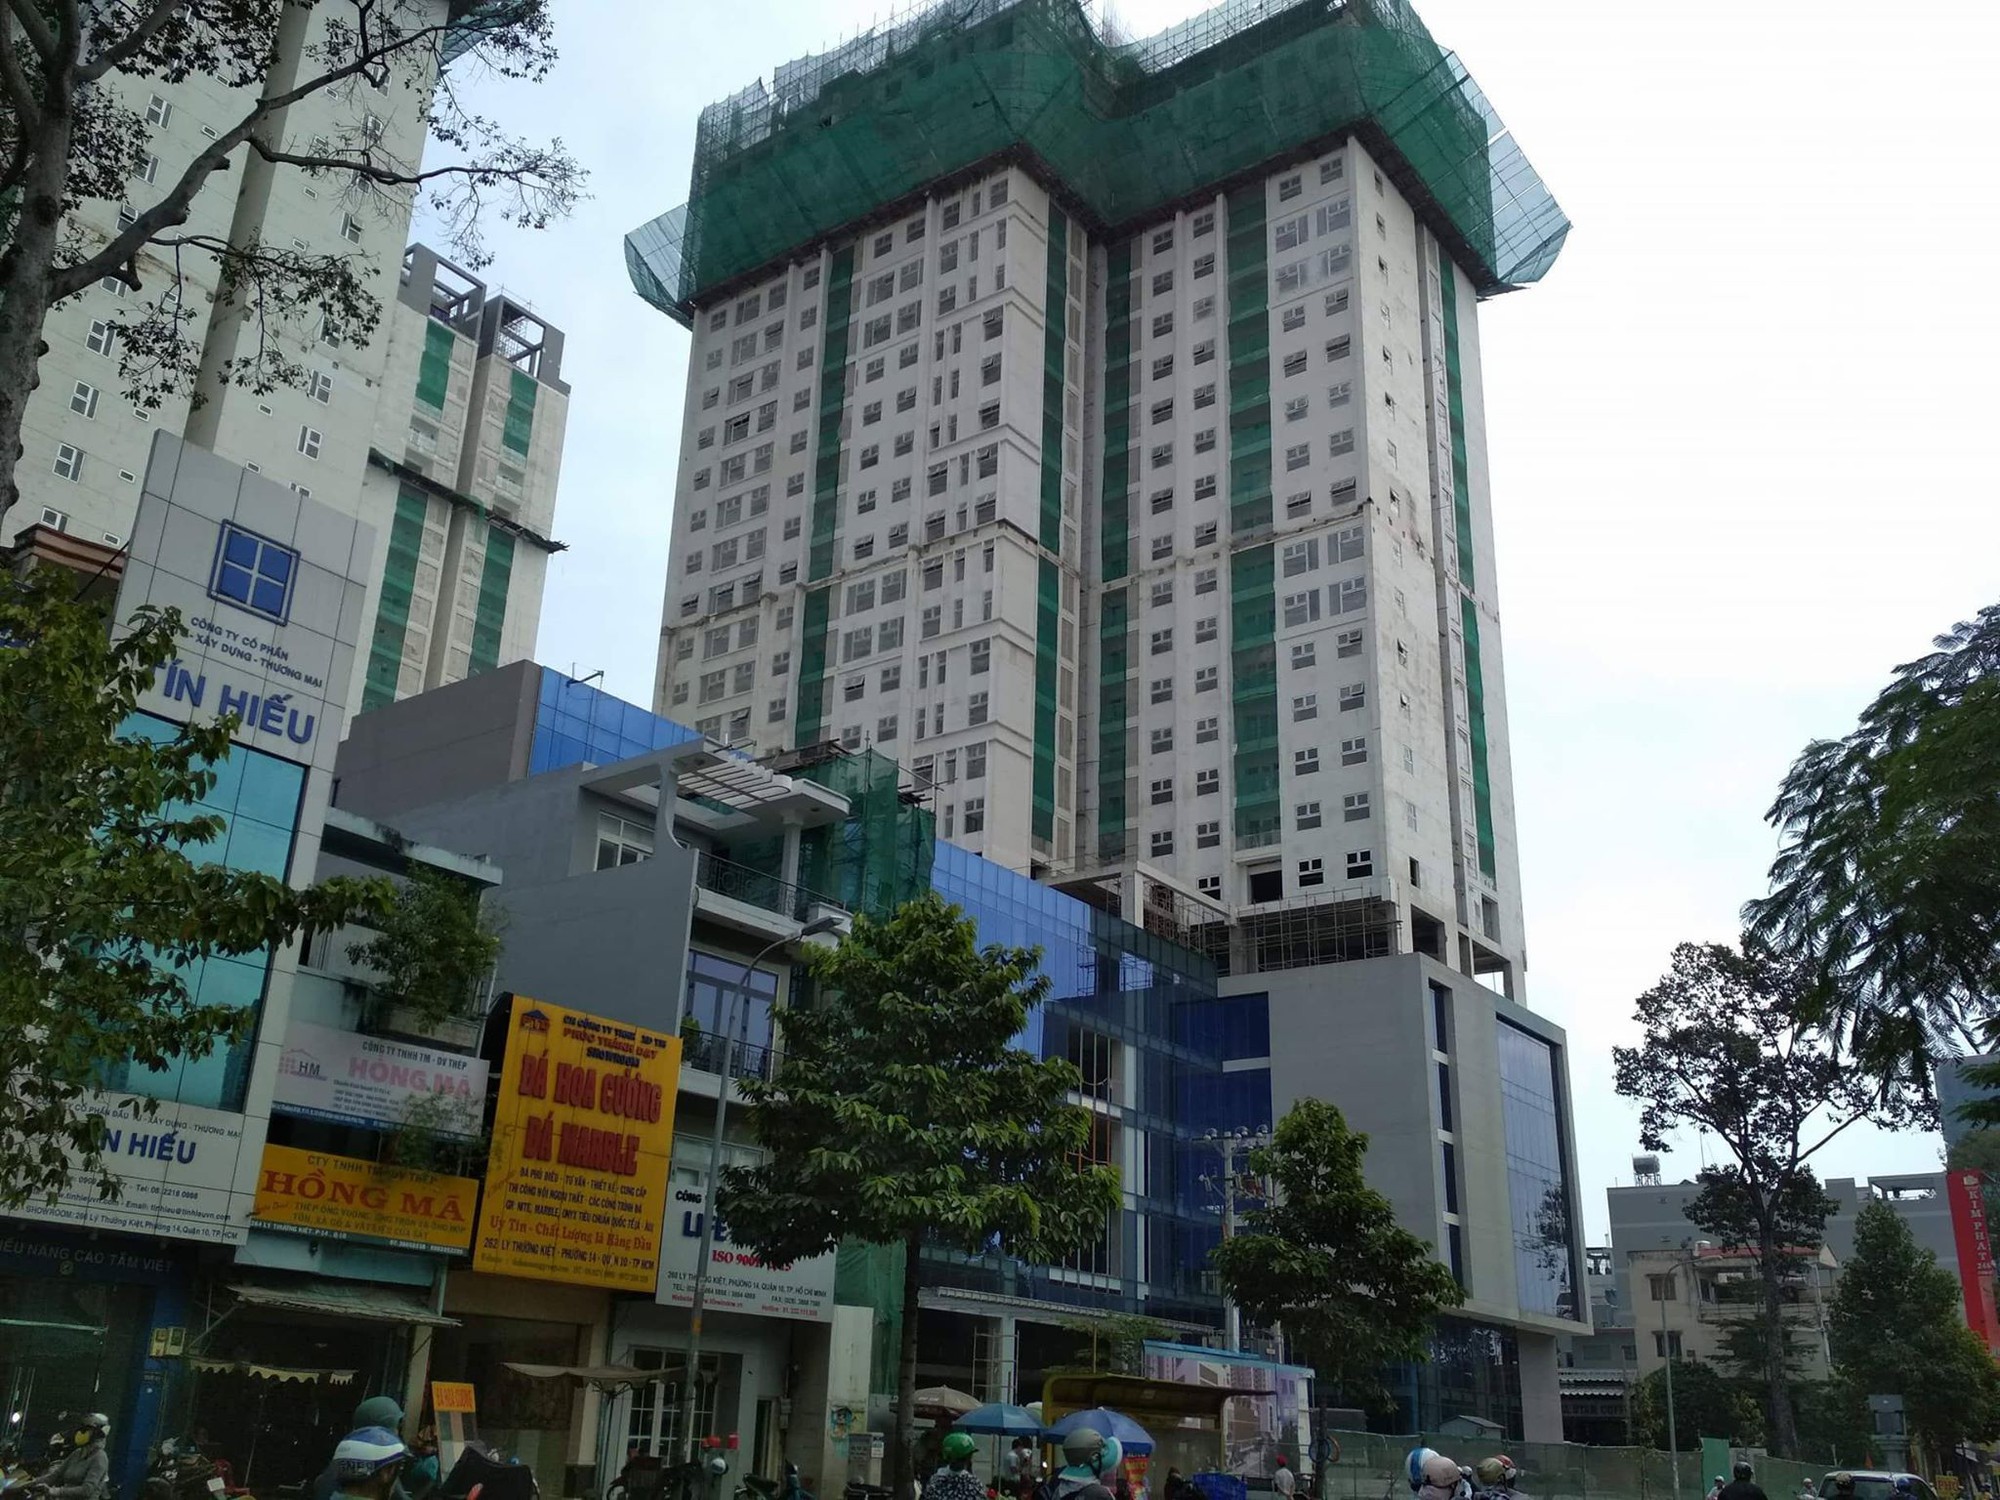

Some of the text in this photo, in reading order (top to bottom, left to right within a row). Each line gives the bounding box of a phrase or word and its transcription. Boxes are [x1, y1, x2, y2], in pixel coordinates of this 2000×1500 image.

[190, 616, 222, 636] CÔNG
[225, 629, 240, 642] TY
[196, 633, 323, 688] XÂY DỰNG THƯƠNG MẠI
[386, 1046, 396, 1056] TY
[398, 1048, 418, 1061] TNHH
[420, 1053, 430, 1062] TM
[437, 1057, 448, 1066] DV
[518, 1049, 548, 1100] ĐÁ
[554, 1062, 596, 1110] HOA
[128, 1130, 197, 1164] HIẾU
[524, 1110, 640, 1176] ĐÁ MARBLE
[308, 1154, 328, 1166] CTY
[334, 1158, 363, 1172] TNHH
[262, 1168, 388, 1209] HỒNG
[74, 1249, 106, 1265] CAO
[712, 1249, 734, 1264] ISO
